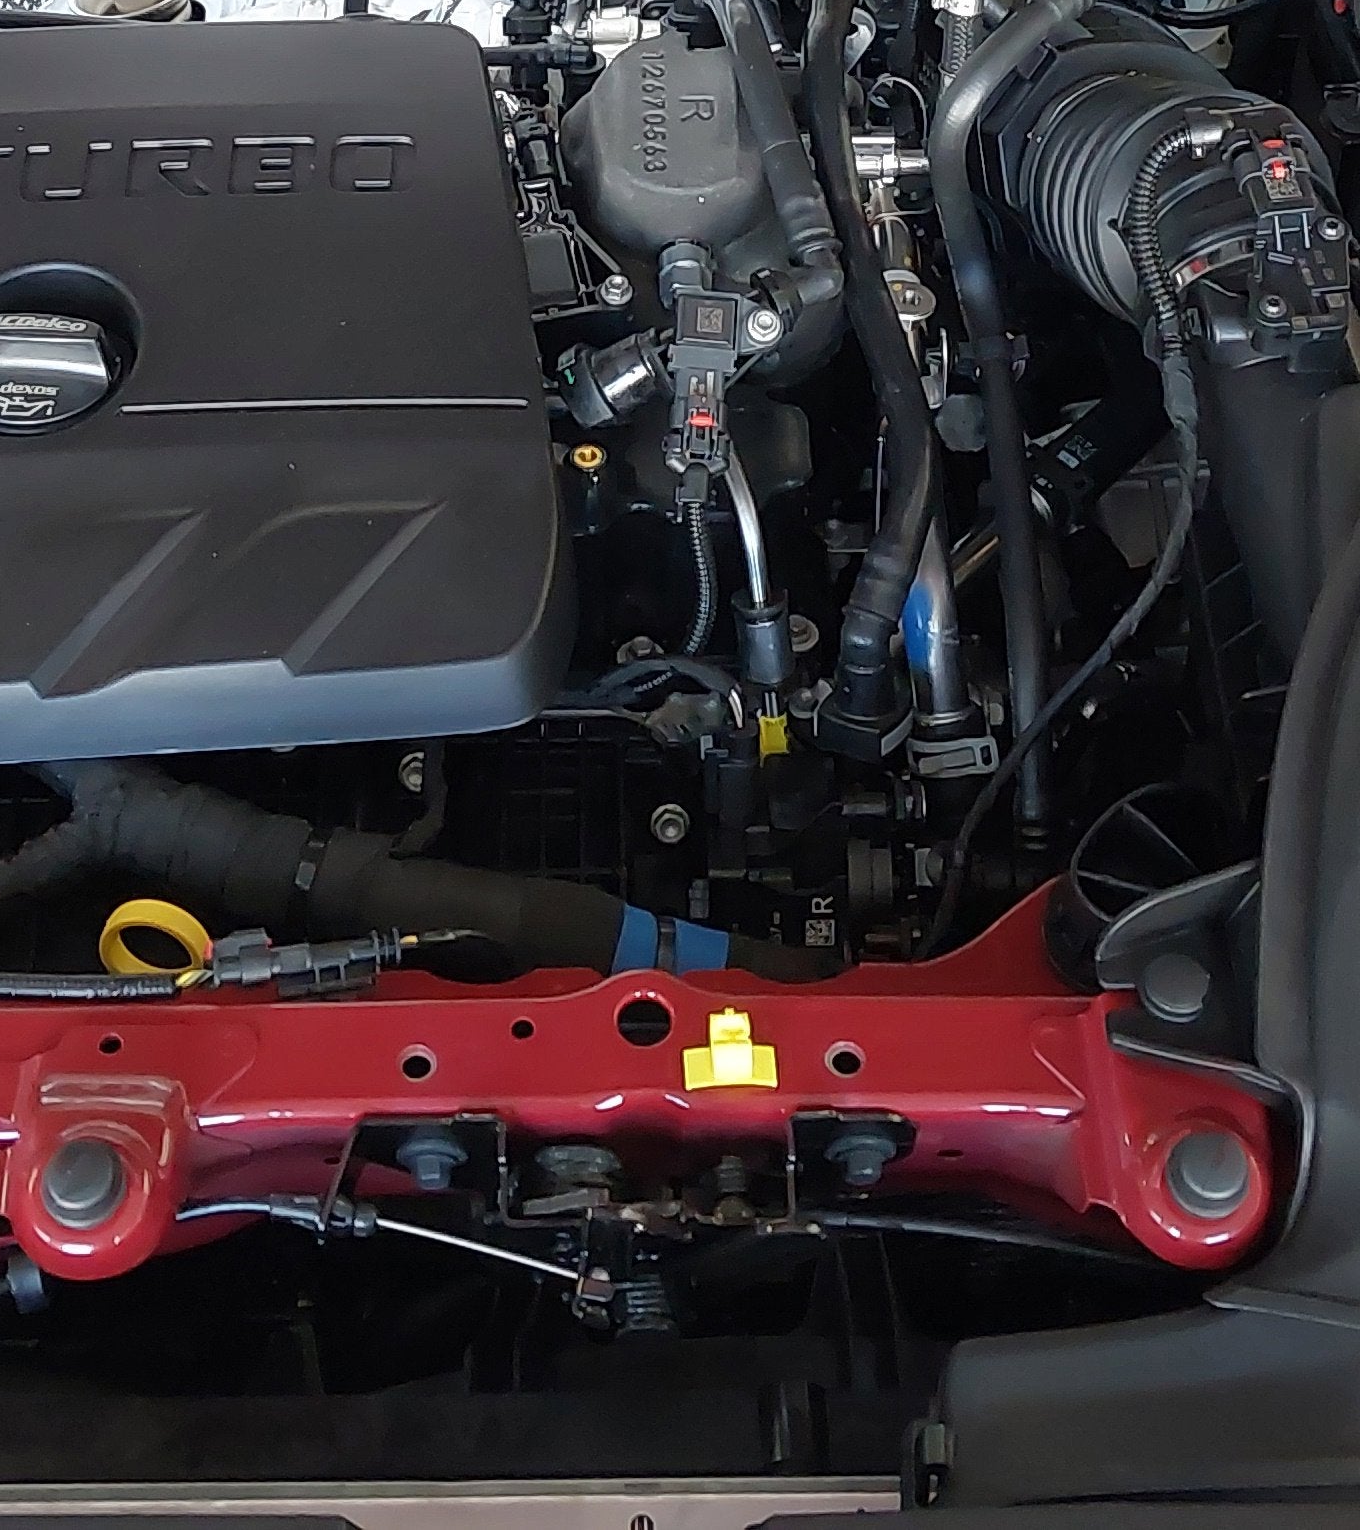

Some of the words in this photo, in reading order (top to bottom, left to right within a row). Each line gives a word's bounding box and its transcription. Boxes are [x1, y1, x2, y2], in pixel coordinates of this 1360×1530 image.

[679, 94, 717, 122] R
[0, 381, 60, 396] dexos
[811, 896, 834, 914] R
